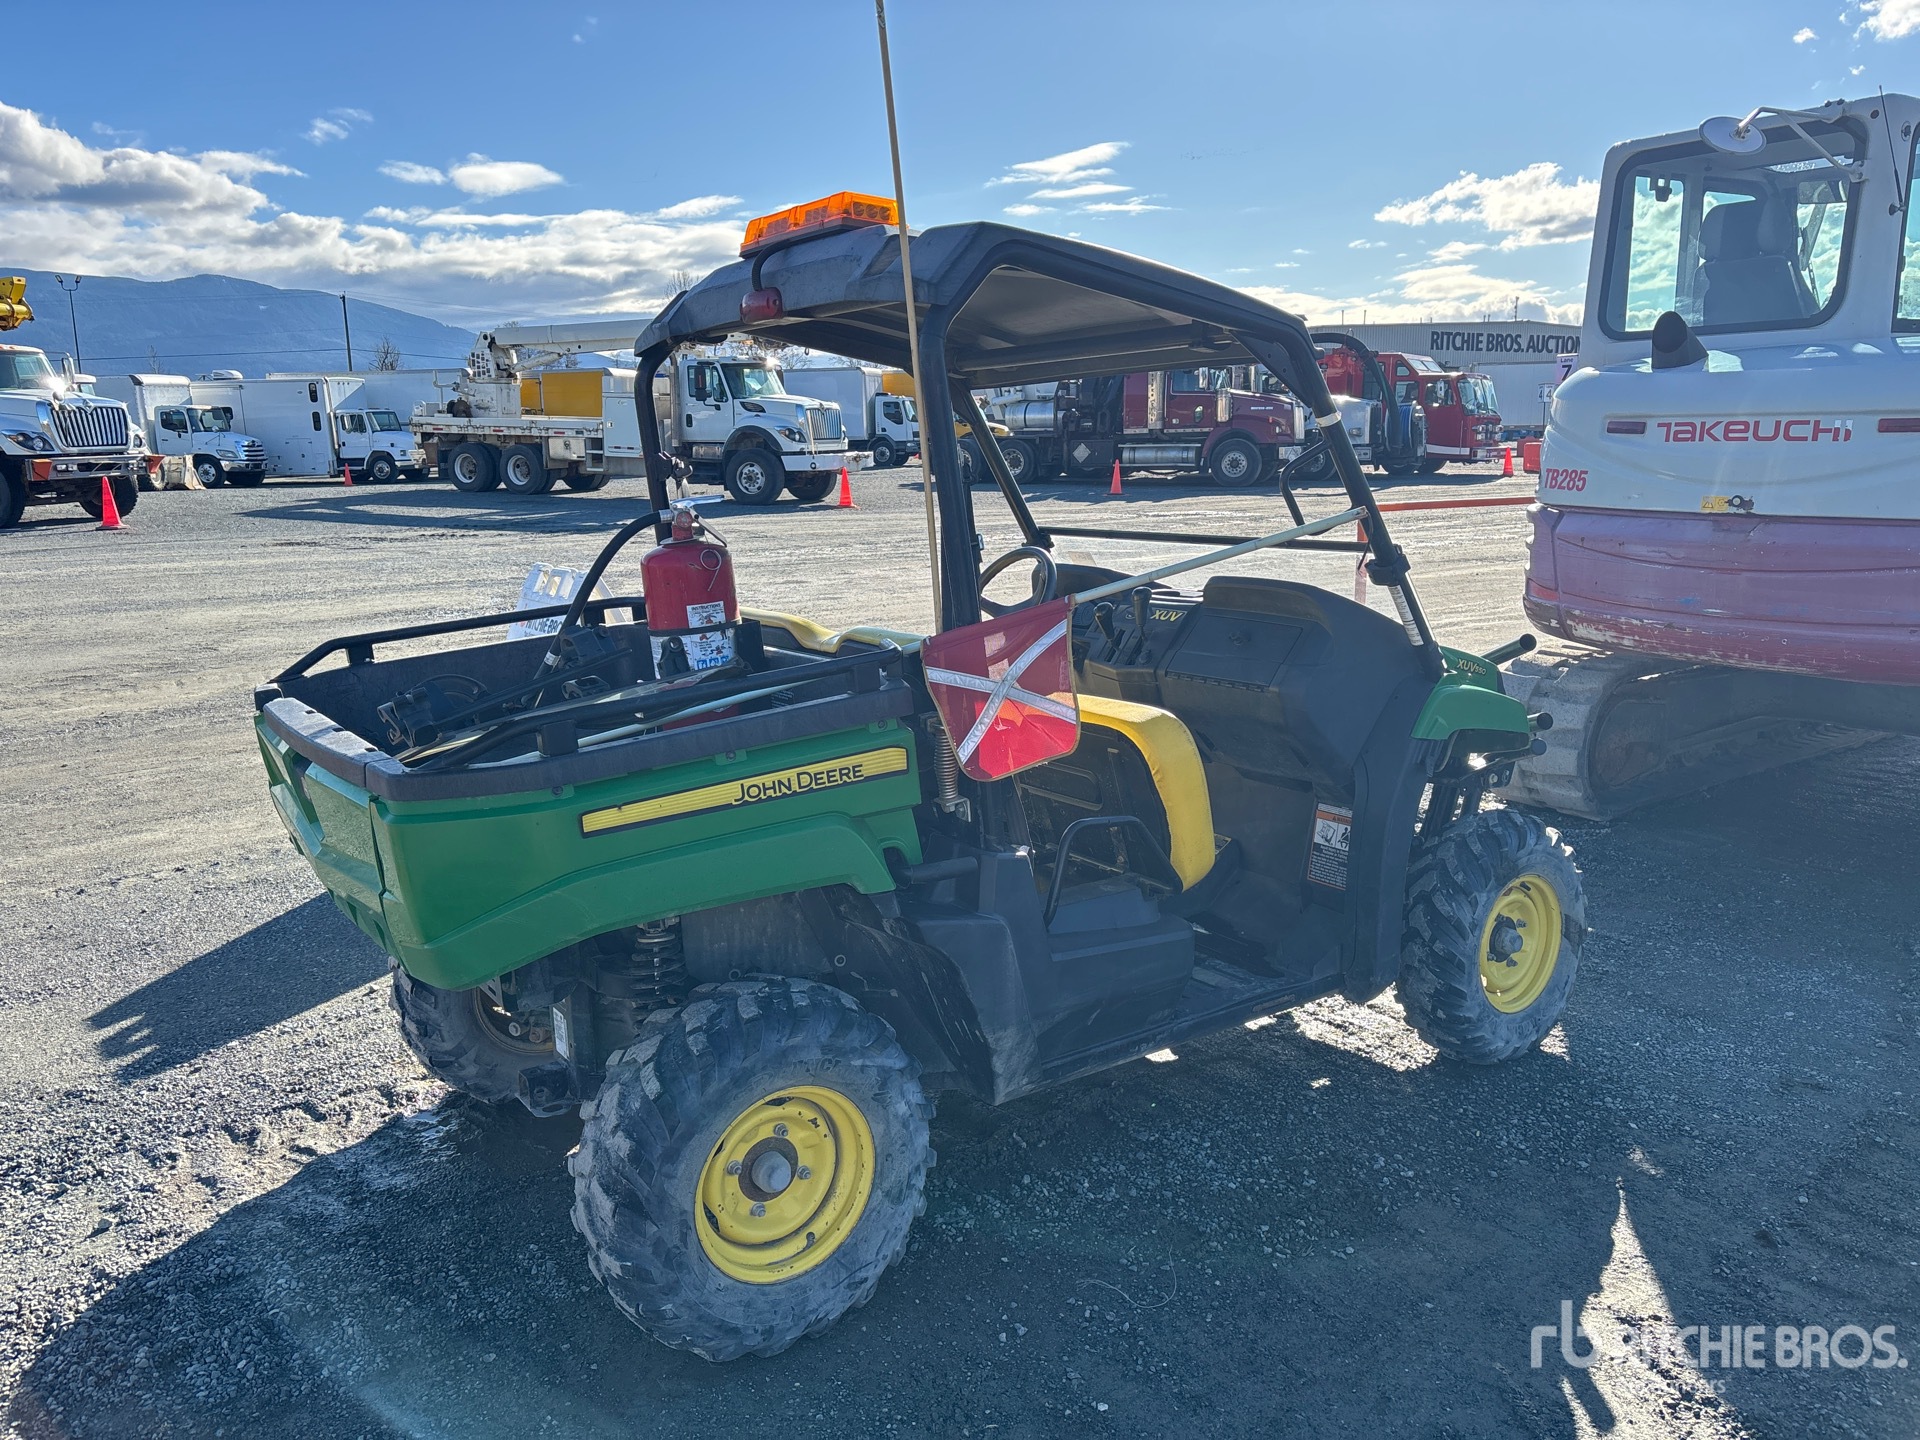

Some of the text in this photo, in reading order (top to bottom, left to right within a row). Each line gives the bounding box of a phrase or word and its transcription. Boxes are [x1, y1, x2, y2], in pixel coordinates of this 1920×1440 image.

[1431, 331, 1483, 351] RITCHIE
[1486, 333, 1525, 353] BROS.
[1561, 364, 1573, 382] 7
[1544, 468, 1588, 492] TB285
[691, 603, 721, 611] INSTRUCTIONS
[1151, 609, 1184, 622] XUV
[734, 766, 864, 803] JOHN DEERE
